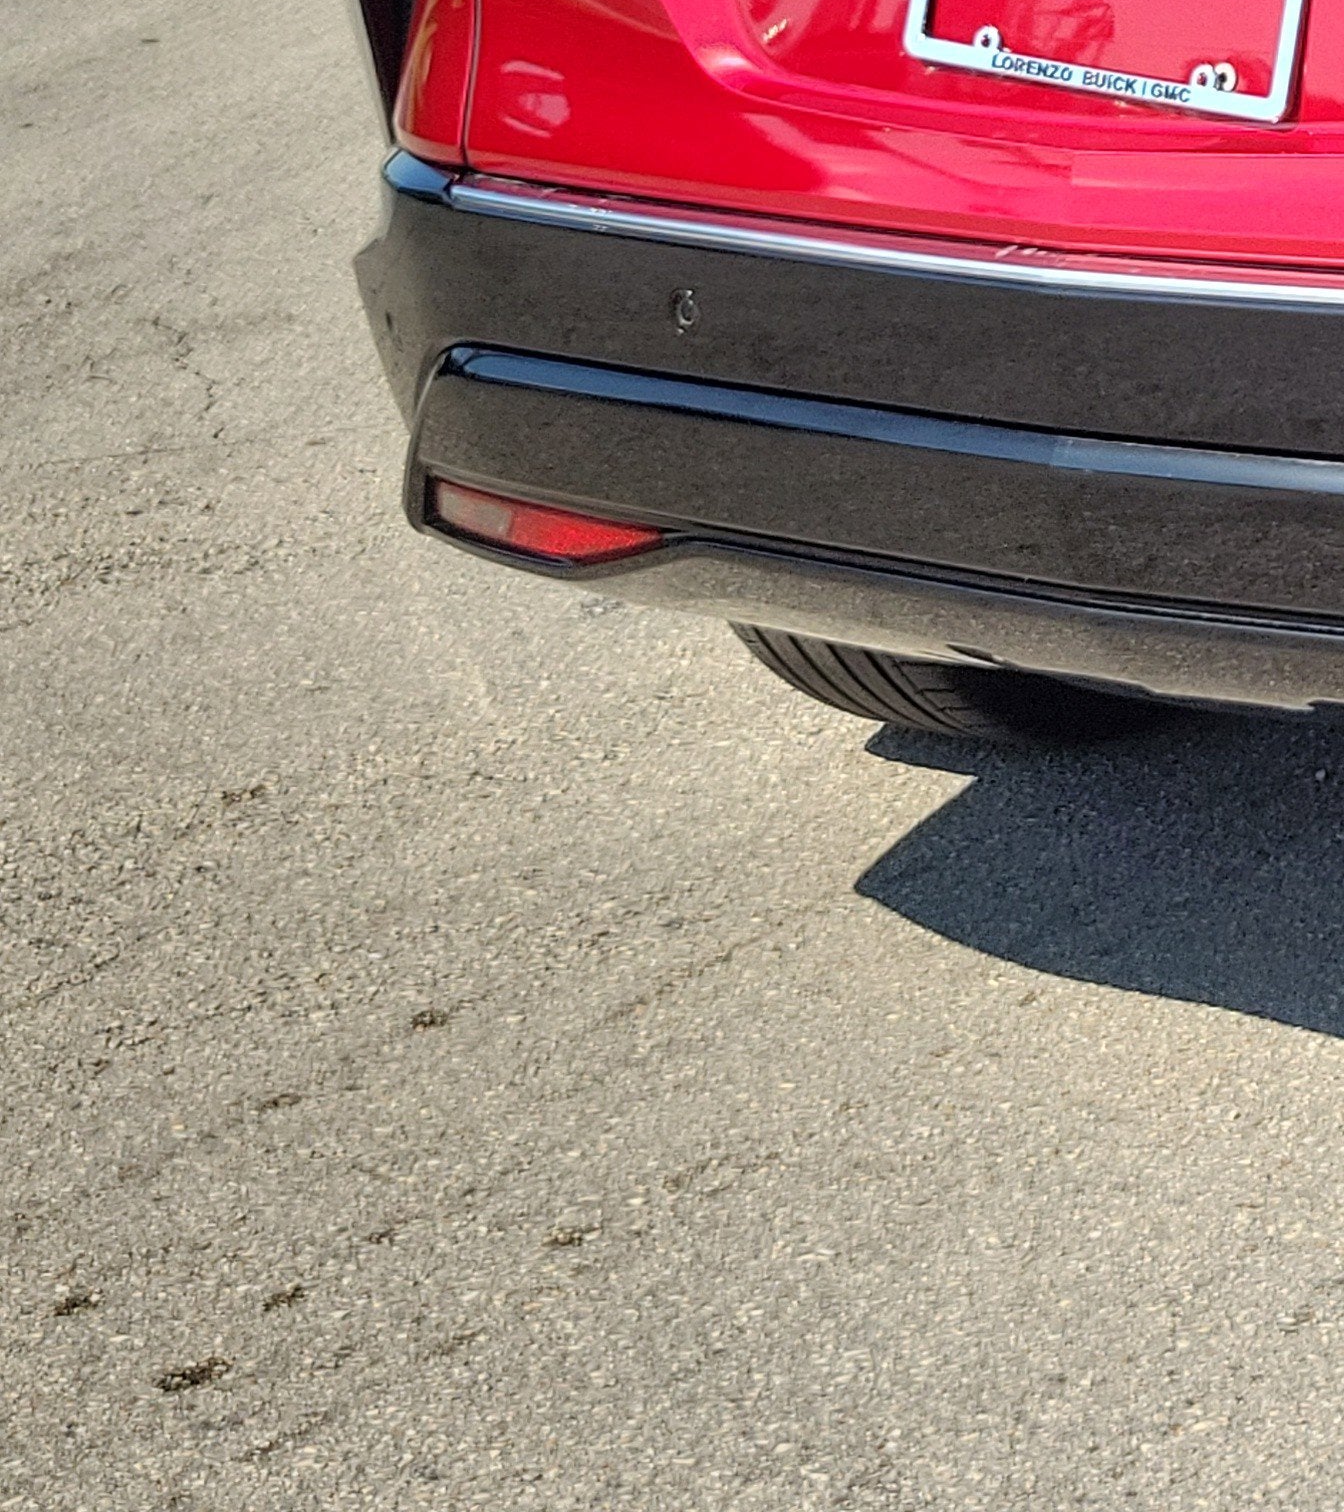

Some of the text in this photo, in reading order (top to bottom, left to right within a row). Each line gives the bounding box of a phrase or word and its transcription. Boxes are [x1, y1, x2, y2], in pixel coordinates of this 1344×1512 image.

[991, 53, 1073, 82] LORENZO
[1082, 70, 1138, 94] BUICK
[1150, 83, 1191, 103] GMC
